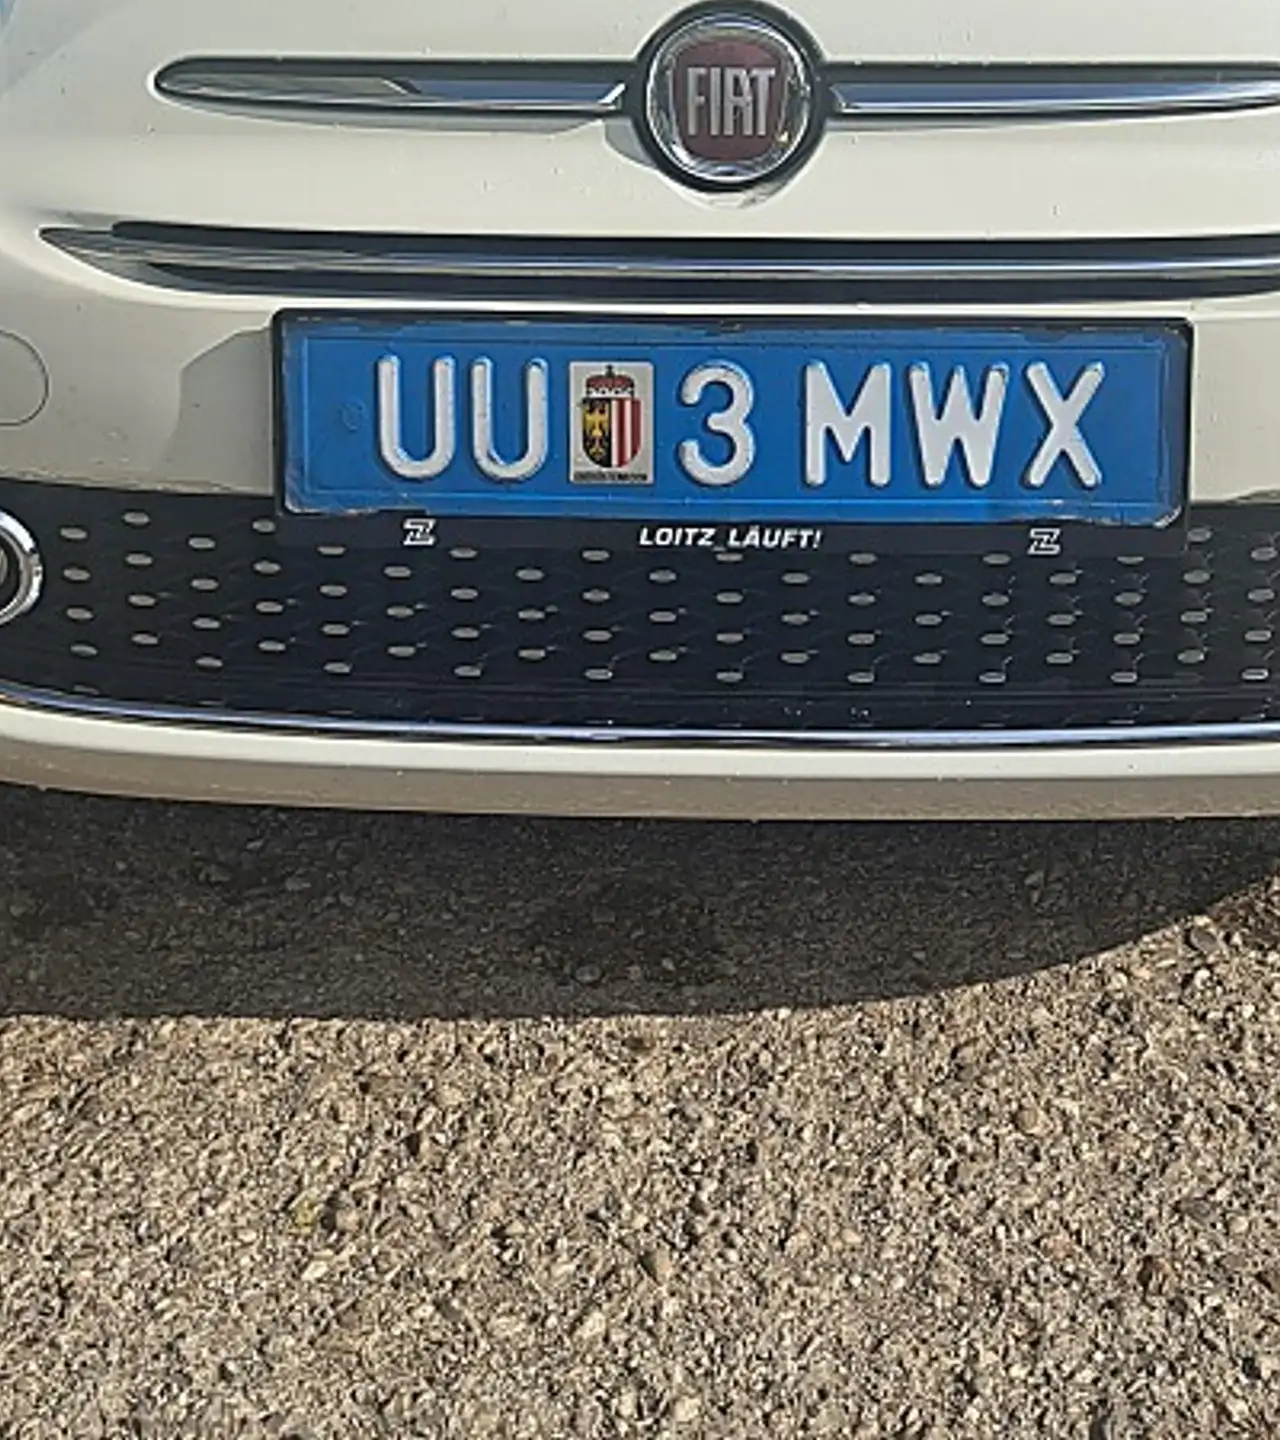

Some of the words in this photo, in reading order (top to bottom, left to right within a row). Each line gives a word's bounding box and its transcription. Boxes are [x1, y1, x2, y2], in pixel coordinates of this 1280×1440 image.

[687, 67, 776, 137] FIAT
[377, 355, 549, 482] UU
[679, 360, 756, 487] 3
[805, 359, 1105, 488] MWX
[639, 527, 715, 548] LOITZ
[728, 526, 823, 550] LÄUFT!
